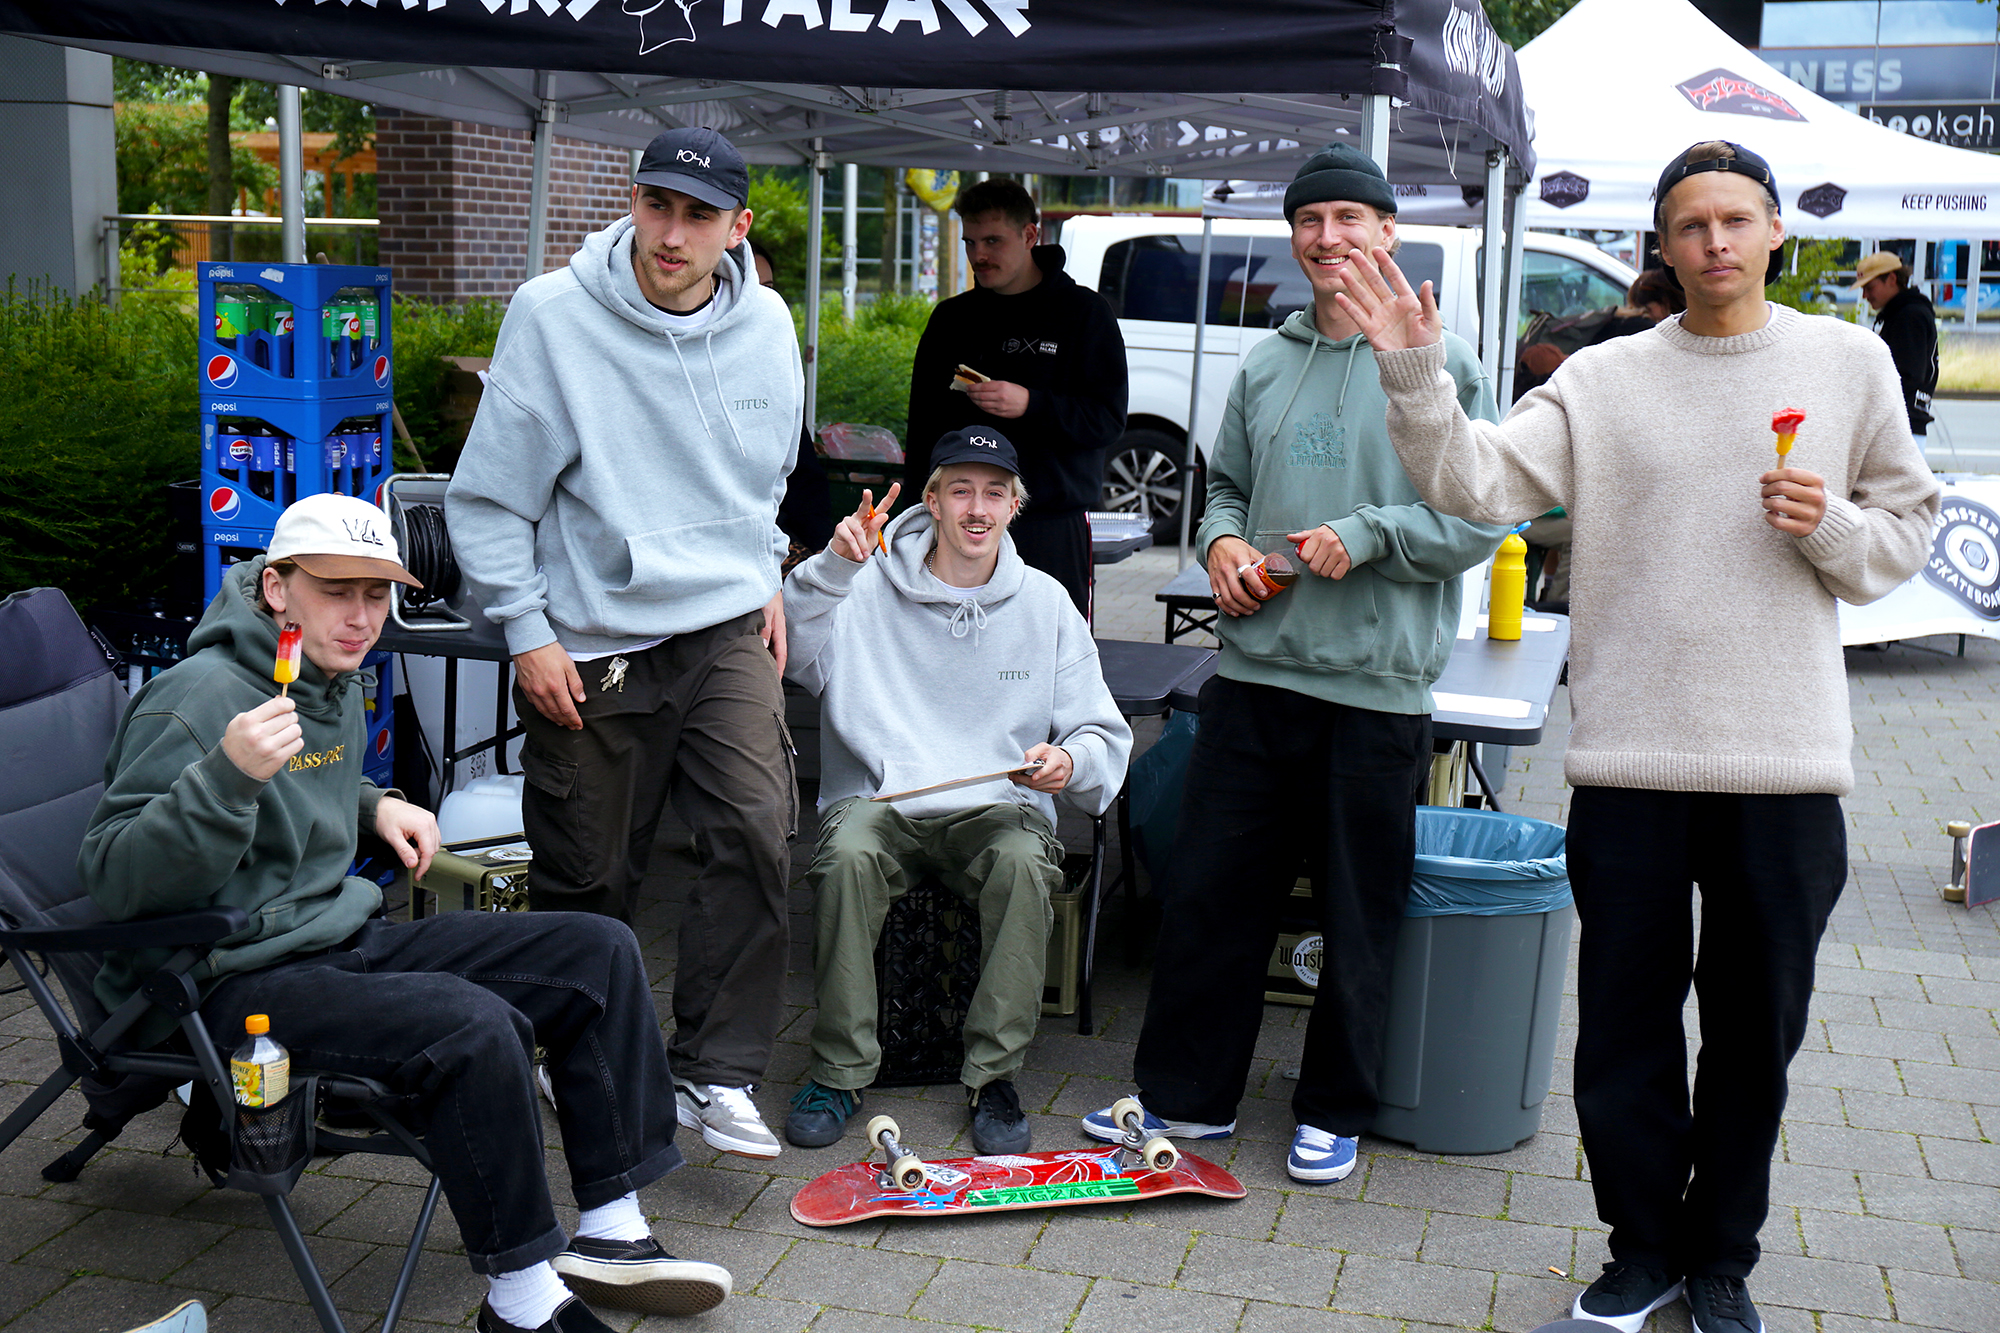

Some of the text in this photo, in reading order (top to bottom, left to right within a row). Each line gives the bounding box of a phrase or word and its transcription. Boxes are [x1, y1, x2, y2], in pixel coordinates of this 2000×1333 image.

[1768, 59, 1902, 93] NESS
[1901, 193, 1987, 211] KEEP PUSHING
[208, 268, 235, 279] pepsi
[375, 273, 389, 283] pepsi
[211, 402, 238, 413] pepsi
[375, 400, 390, 412] pepsi
[733, 398, 769, 411] TITUS
[213, 532, 240, 543] pepsi
[997, 669, 1031, 681] TITUS
[1005, 1184, 1107, 1205] ZIGZAG
